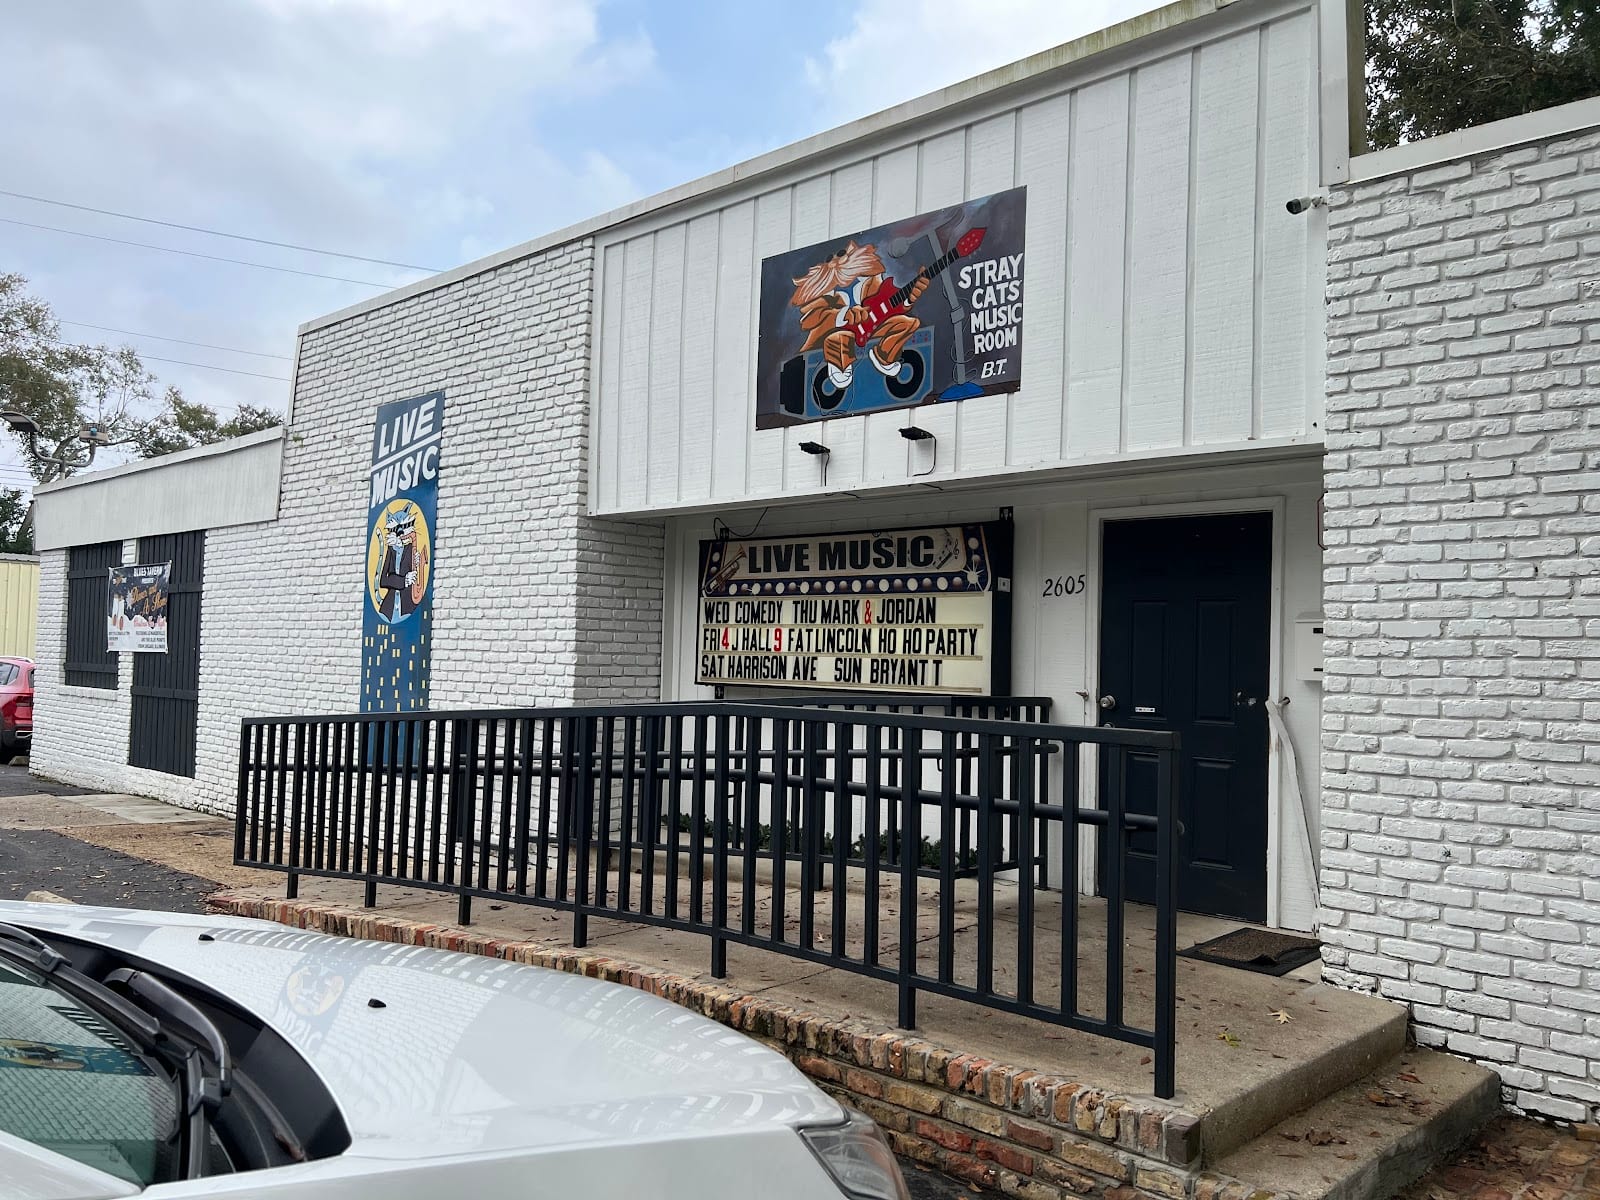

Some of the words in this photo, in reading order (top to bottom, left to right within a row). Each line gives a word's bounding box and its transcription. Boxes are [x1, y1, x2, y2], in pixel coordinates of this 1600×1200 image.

[958, 253, 1023, 289] STRAY
[970, 303, 1022, 333] MUSIC
[974, 326, 1017, 354] ROOM
[981, 359, 1007, 379] B.T.
[378, 398, 437, 459] LIVE
[371, 445, 438, 509] MUSIC
[748, 543, 810, 574] LIVE
[818, 535, 934, 571] MUSIC
[1042, 574, 1085, 597] 2605
[704, 601, 729, 624] WED
[735, 600, 783, 624] COMEDY
[793, 600, 817, 624] THU
[820, 599, 860, 625] MARK
[864, 599, 872, 624] &
[876, 597, 936, 624] JORDAN
[703, 628, 720, 650] FRI
[721, 627, 729, 649] 4
[742, 628, 772, 651] HALL
[773, 627, 782, 652] 9
[878, 628, 897, 654] HO
[903, 628, 922, 654] HO
[926, 628, 978, 656] PARTY
[701, 655, 725, 677] SAT
[728, 655, 788, 680] HARRISON
[792, 656, 818, 680] AVE
[834, 657, 862, 683] SUN
[870, 658, 929, 686] BRYANT
[932, 659, 943, 686] T
